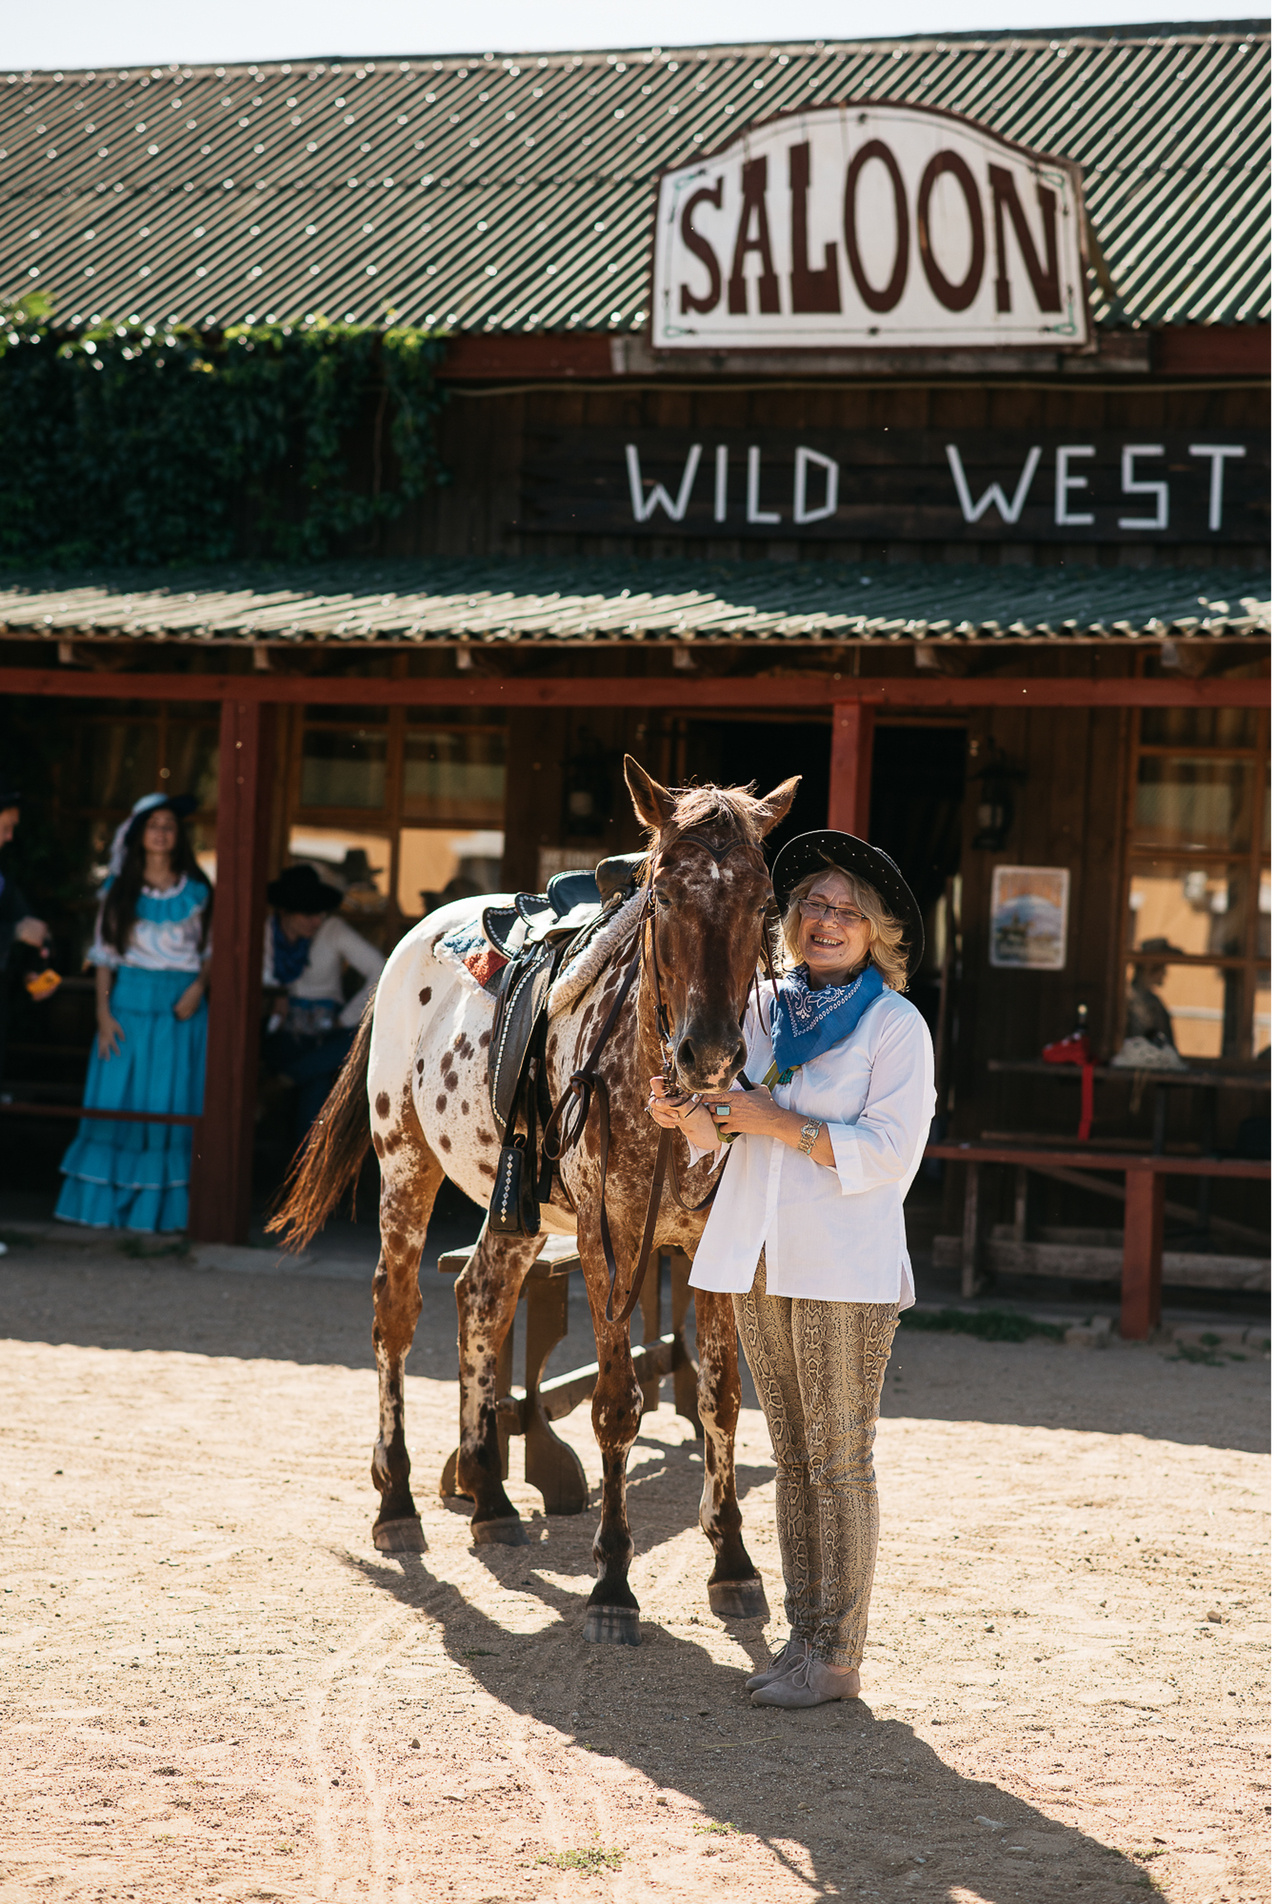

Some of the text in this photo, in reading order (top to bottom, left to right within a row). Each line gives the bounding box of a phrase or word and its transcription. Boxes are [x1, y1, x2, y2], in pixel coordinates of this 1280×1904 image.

[679, 138, 1064, 316] SALOON
[625, 444, 1246, 532] WILD WEST
